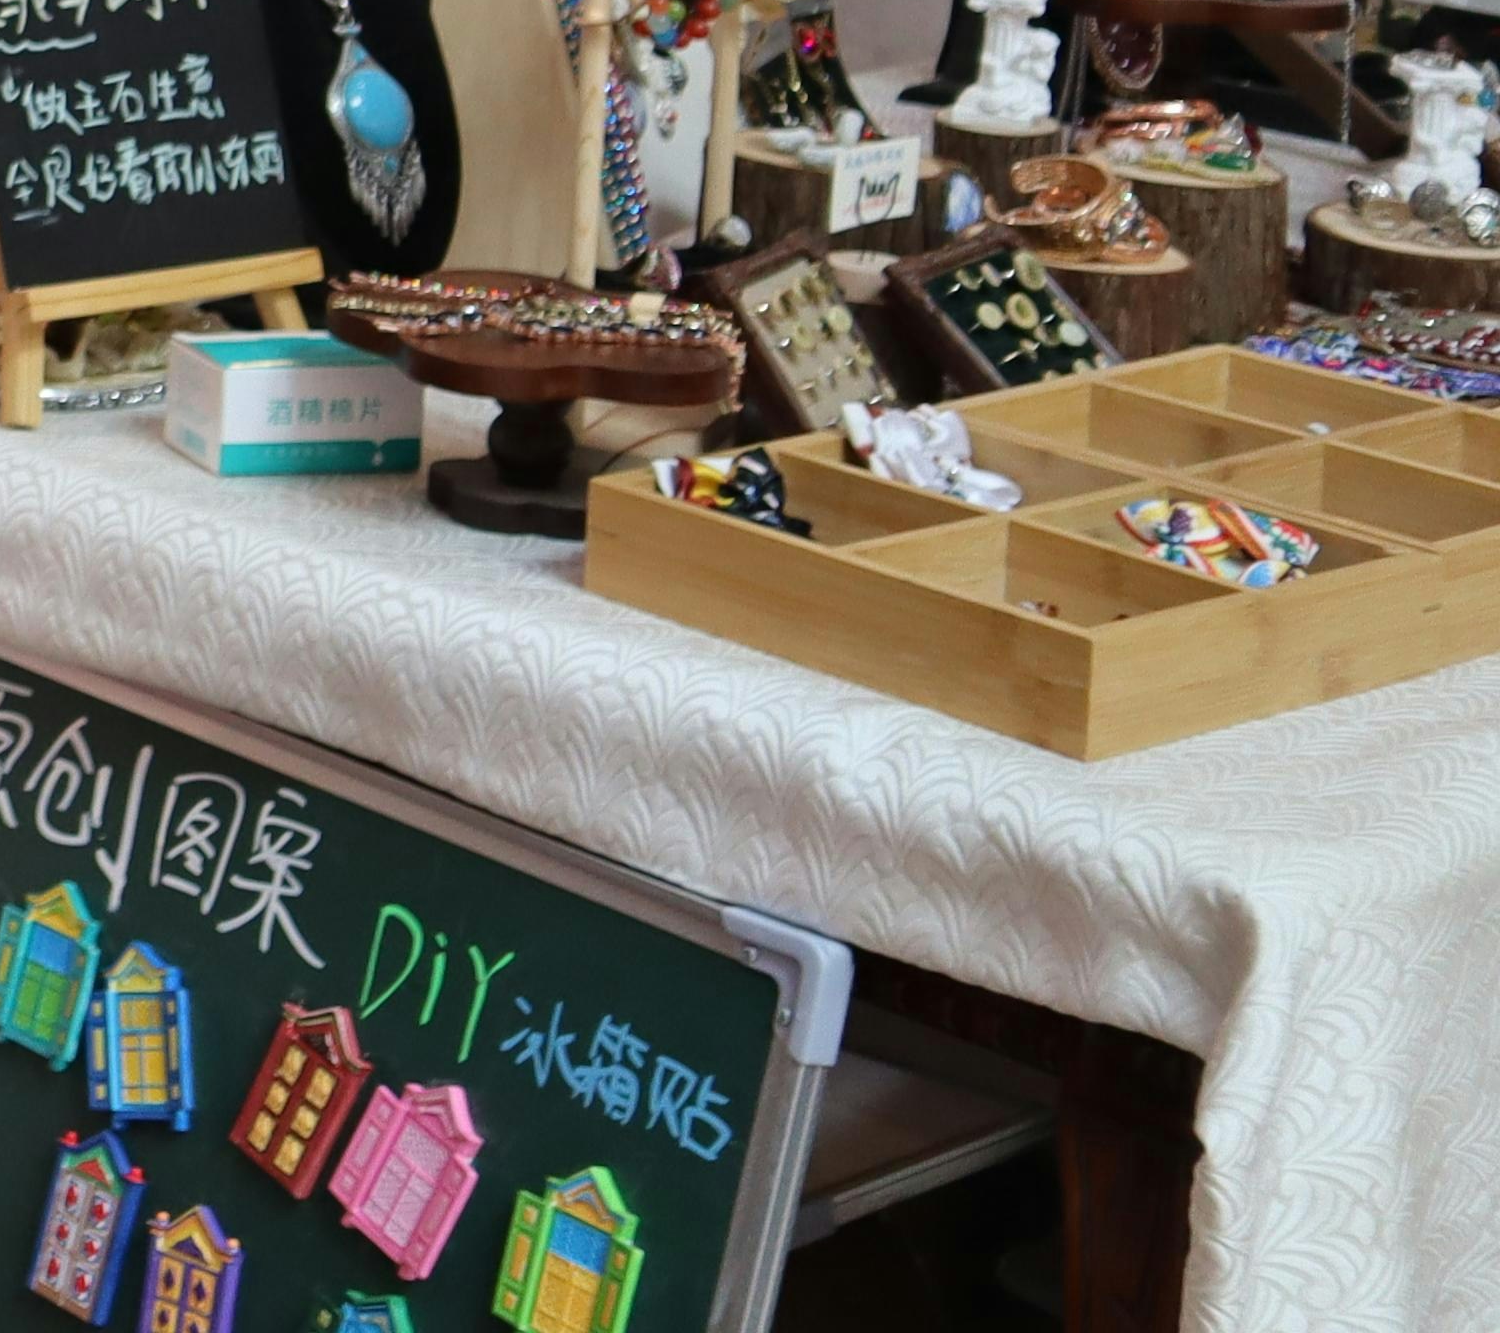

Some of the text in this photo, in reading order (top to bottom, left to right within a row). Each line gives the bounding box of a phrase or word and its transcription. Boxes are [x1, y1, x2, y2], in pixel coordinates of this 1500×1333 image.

[267, 397, 382, 425] 酒精棉片
[501, 997, 732, 1161] 冰箱贴
